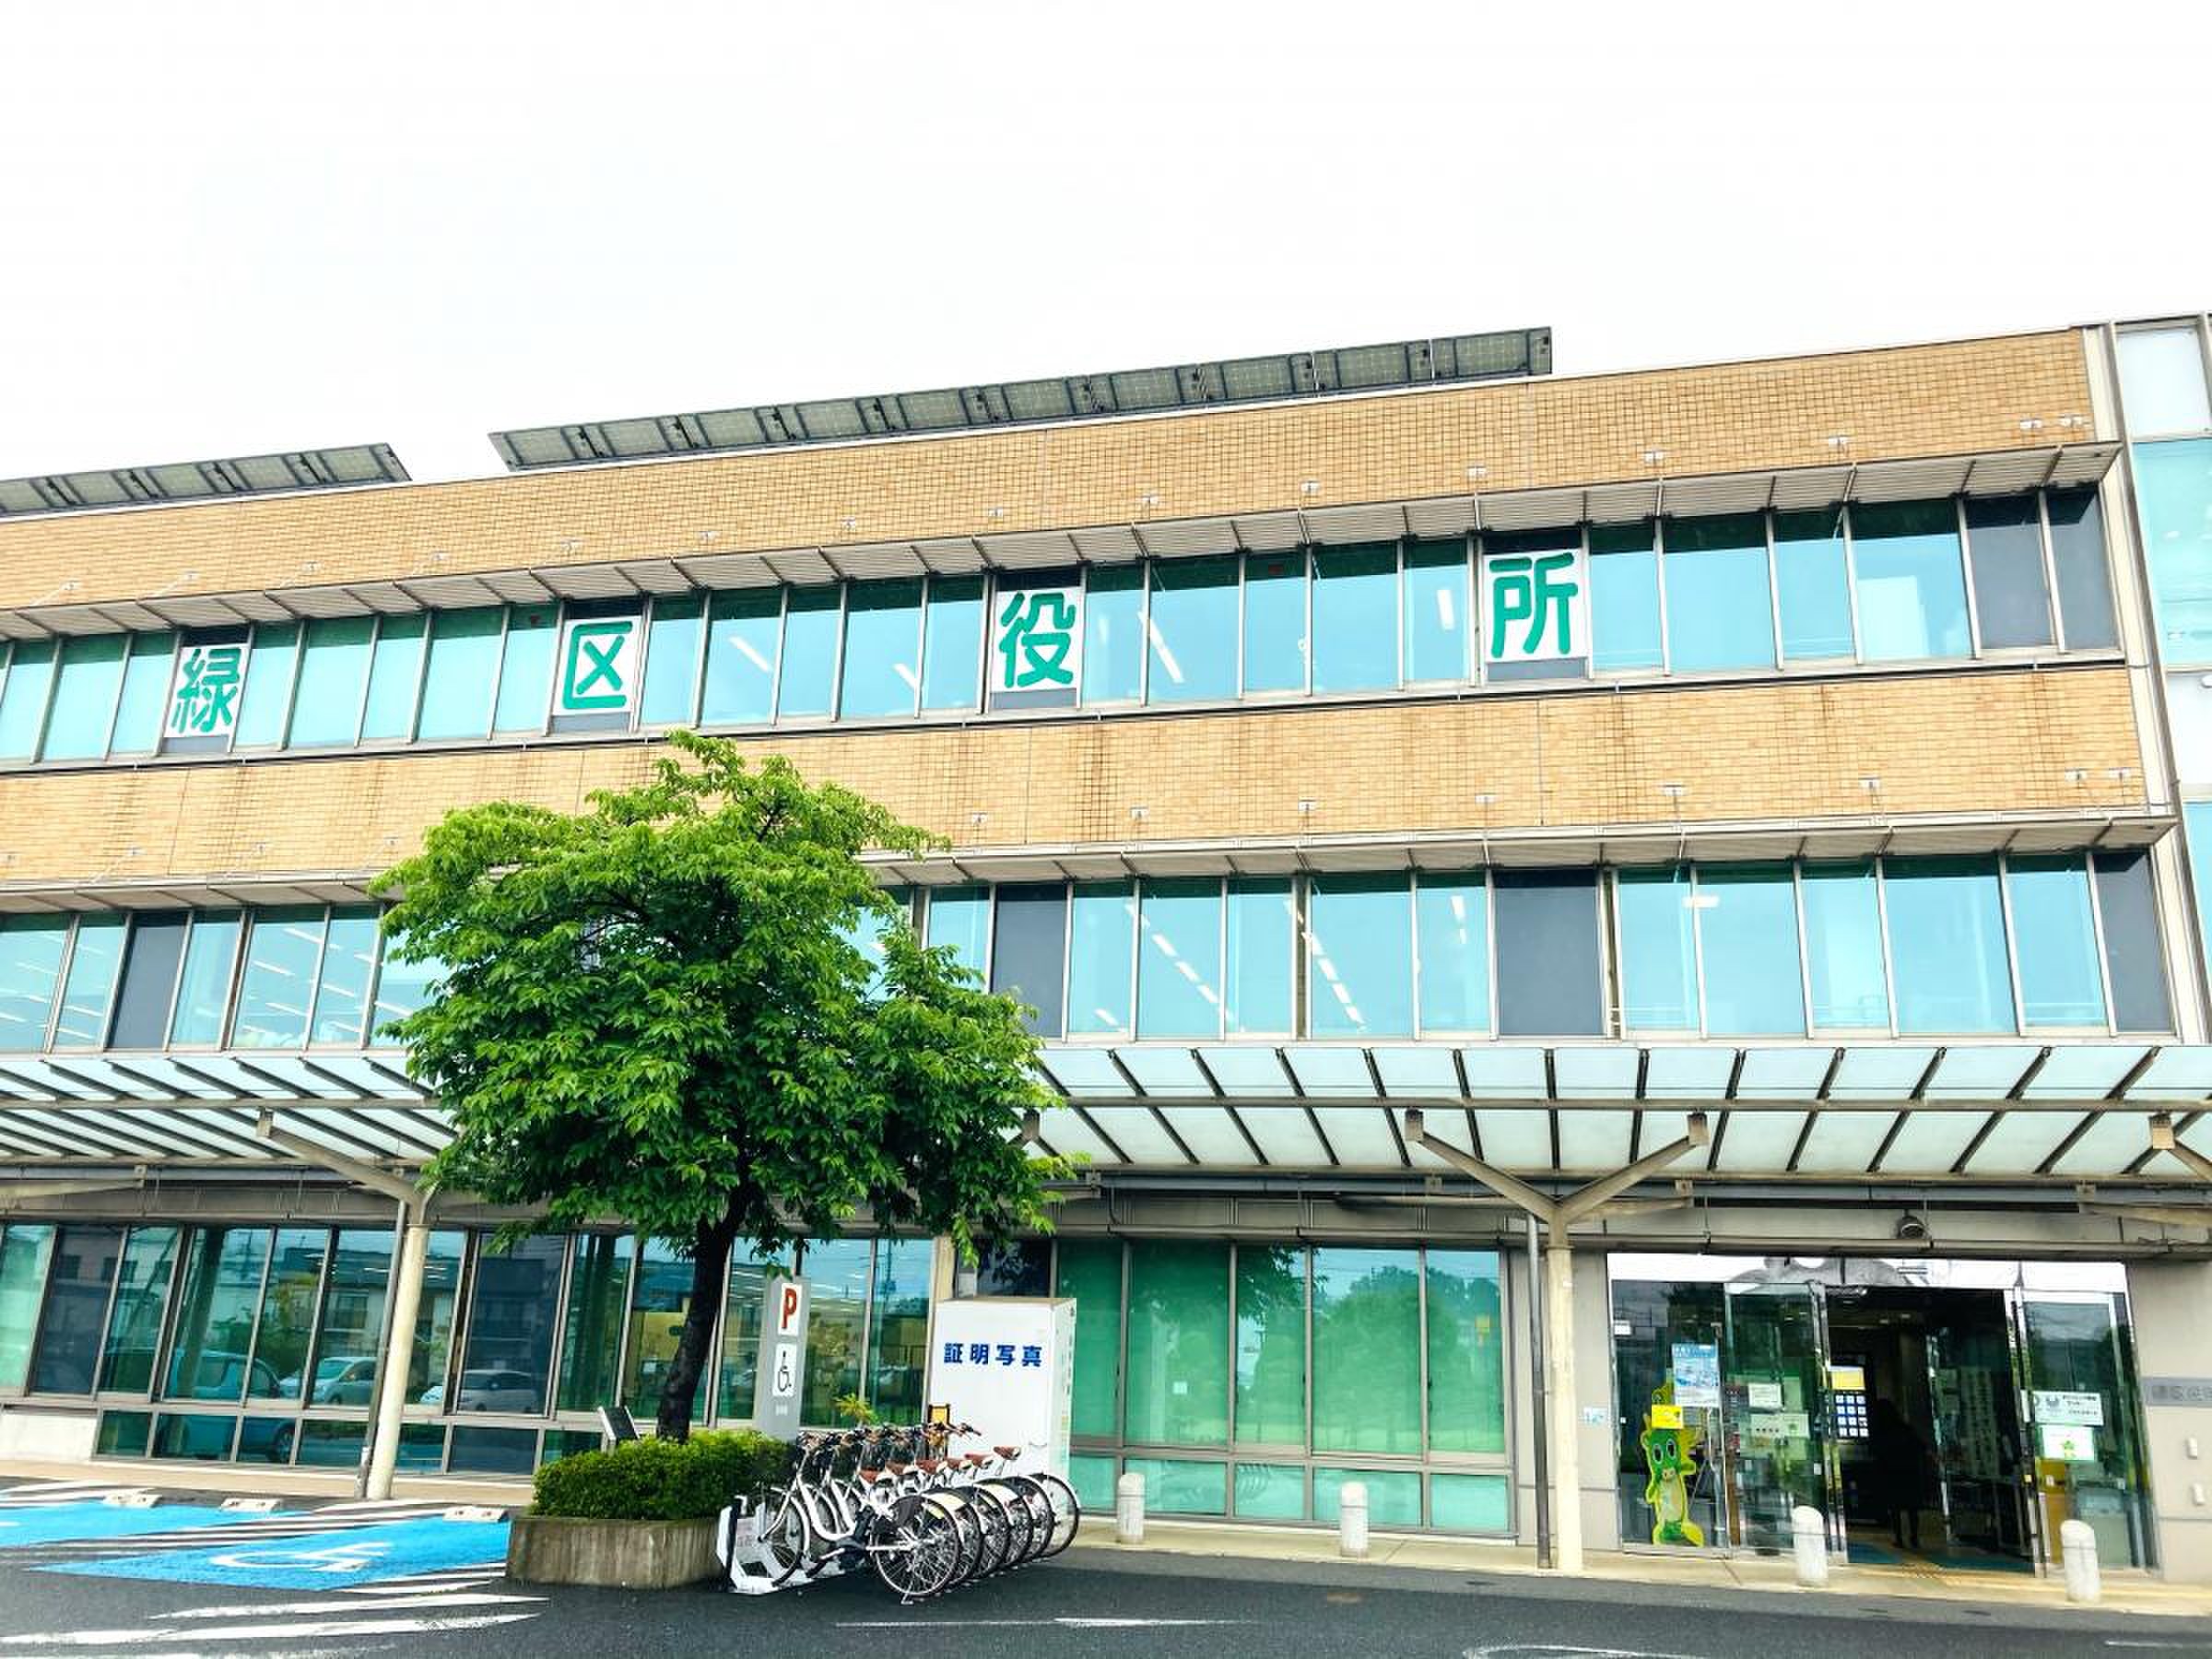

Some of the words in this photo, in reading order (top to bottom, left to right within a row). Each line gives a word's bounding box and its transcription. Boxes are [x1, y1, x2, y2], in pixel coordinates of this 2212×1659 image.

[171, 648, 241, 733] 緑
[563, 621, 632, 709] 区
[999, 592, 1076, 688] 役
[1488, 553, 1578, 658] 所
[782, 1288, 797, 1328] P
[943, 1342, 1042, 1367] 証明写真
